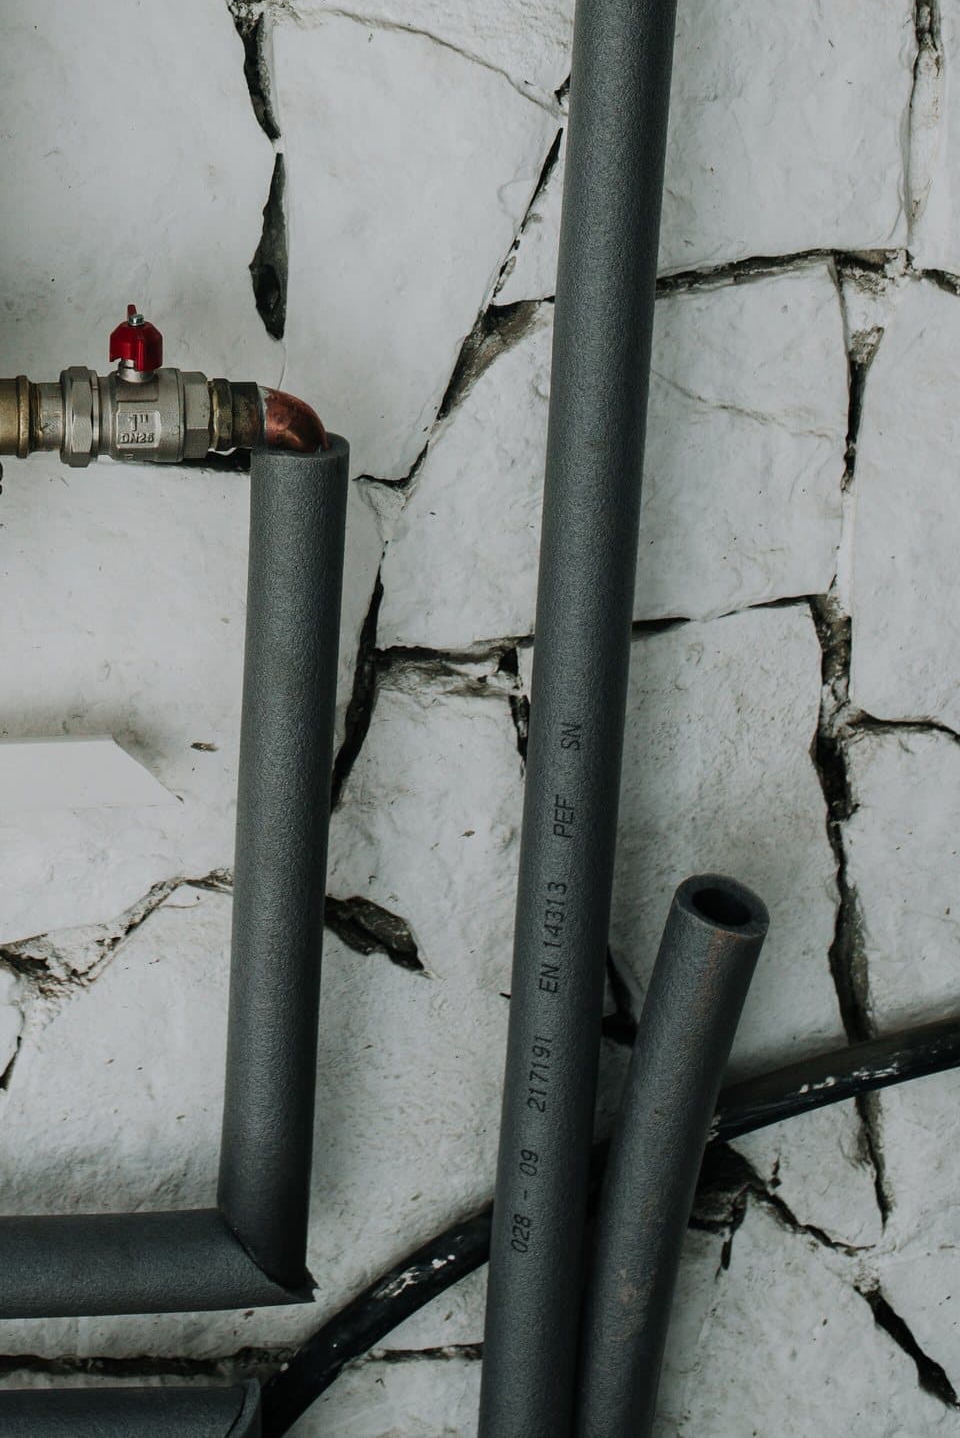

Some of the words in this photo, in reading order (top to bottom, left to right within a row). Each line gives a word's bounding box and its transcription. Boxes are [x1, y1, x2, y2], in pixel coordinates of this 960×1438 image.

[560, 722, 582, 751] SN
[552, 793, 576, 840] PEF
[542, 880, 568, 948] 14313
[538, 963, 560, 994] EN
[526, 1034, 554, 1113] 217191
[518, 1148, 540, 1177] 09
[510, 1212, 532, 1254] 028
